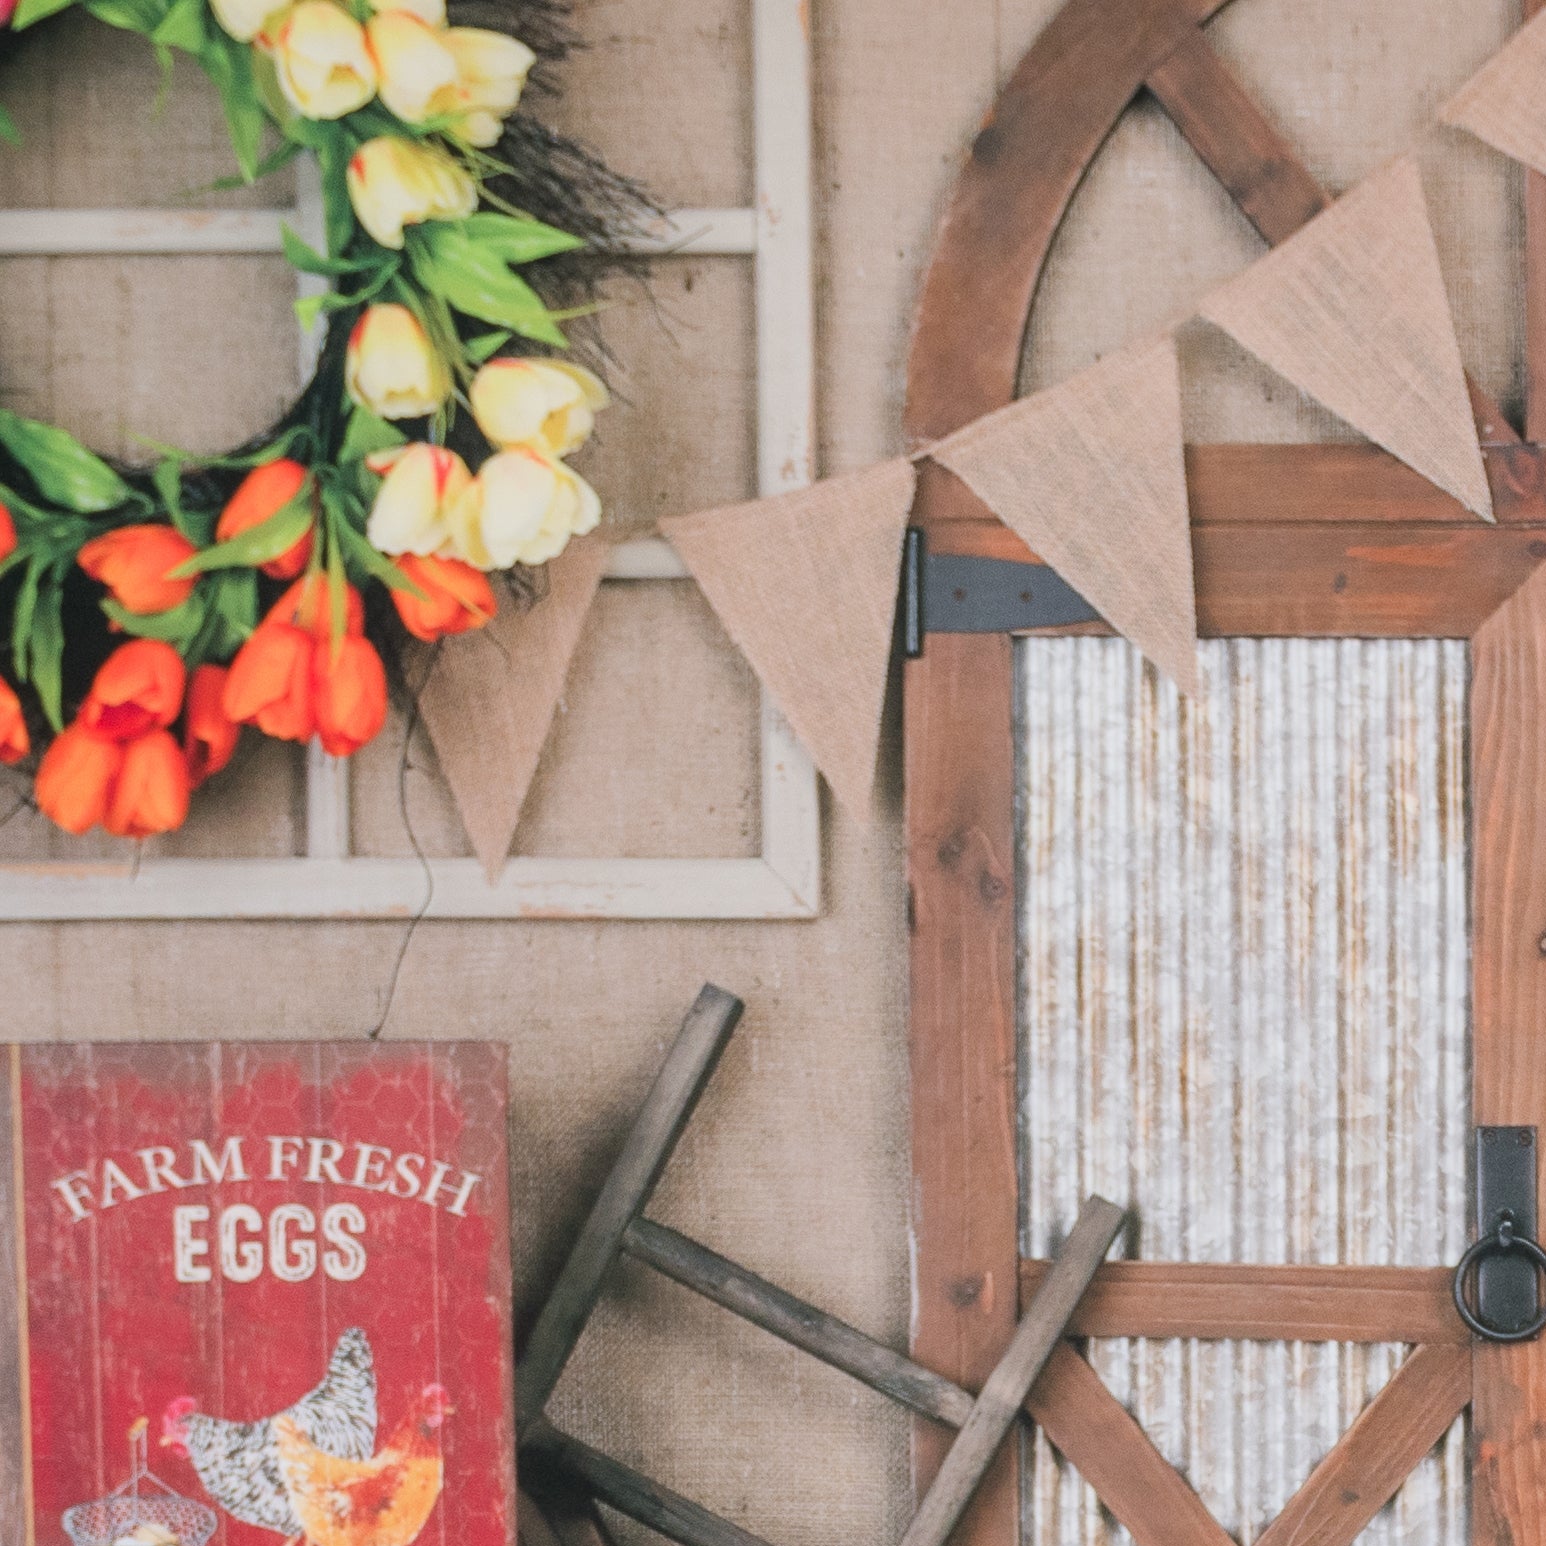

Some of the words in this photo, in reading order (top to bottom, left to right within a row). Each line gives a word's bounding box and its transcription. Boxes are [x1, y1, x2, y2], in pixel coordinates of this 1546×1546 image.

[51, 1135, 249, 1222] FARM
[267, 1135, 482, 1217] FRESH
[172, 1203, 368, 1283] EGGS
